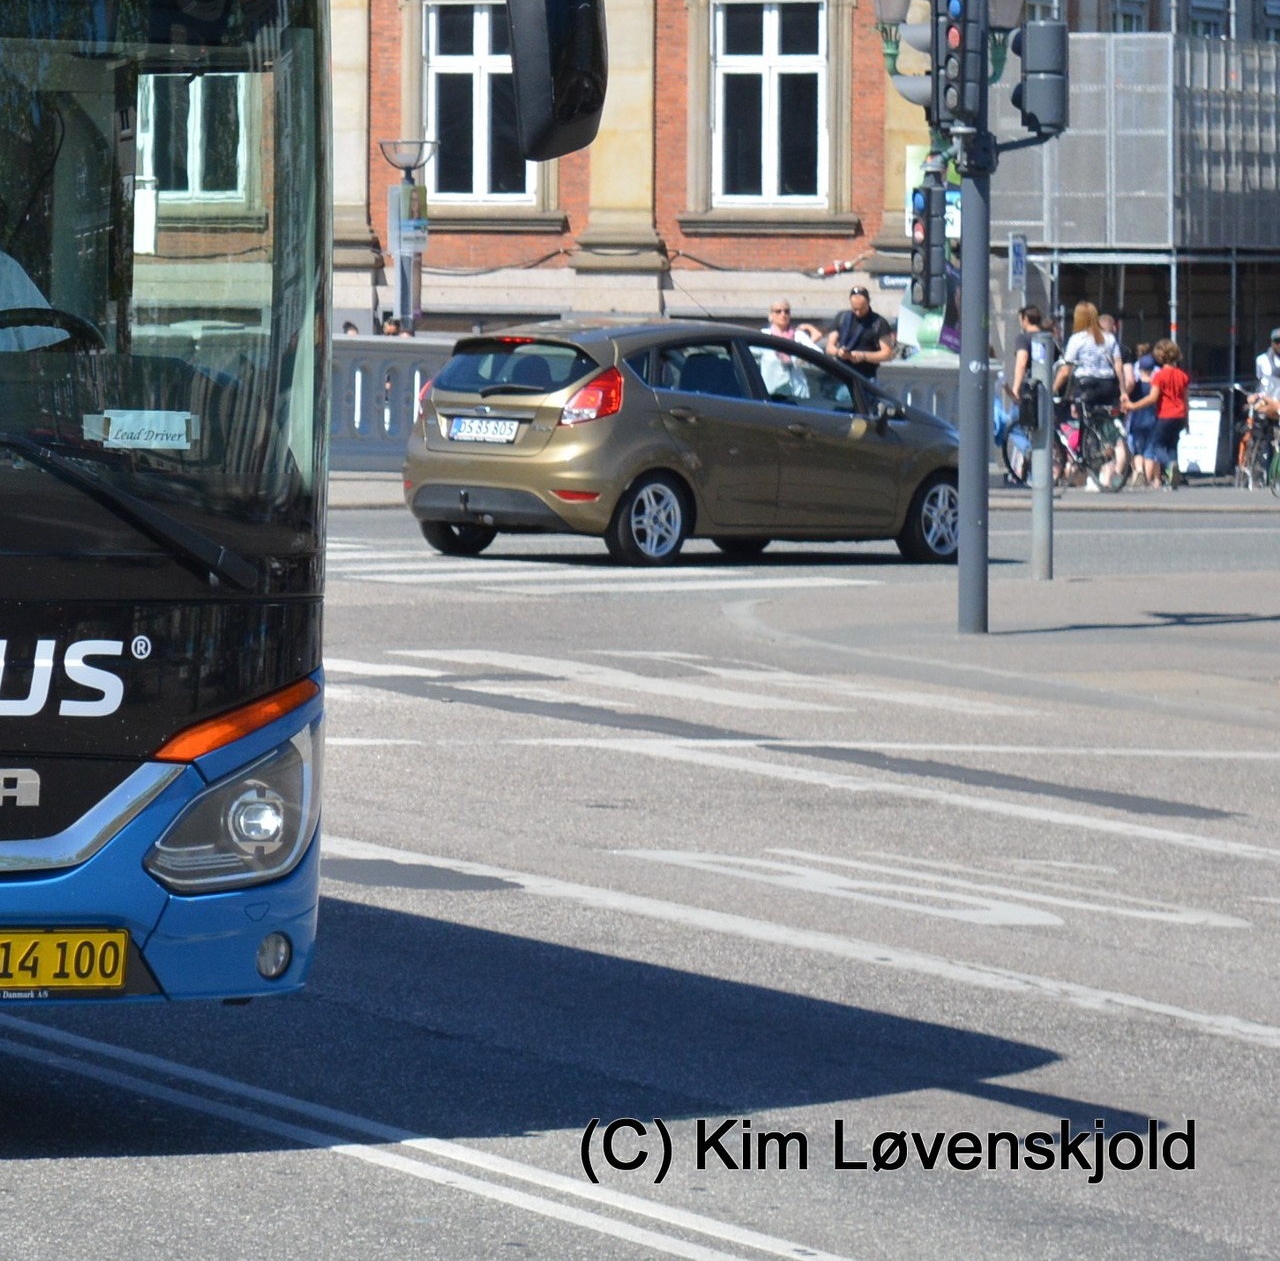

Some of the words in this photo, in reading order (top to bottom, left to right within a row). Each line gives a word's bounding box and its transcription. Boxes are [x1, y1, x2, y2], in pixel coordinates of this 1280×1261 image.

[113, 428, 144, 441] Lead
[144, 429, 185, 442] Driver
[52, 940, 121, 979] 100
[2, 990, 35, 999] Danmark
